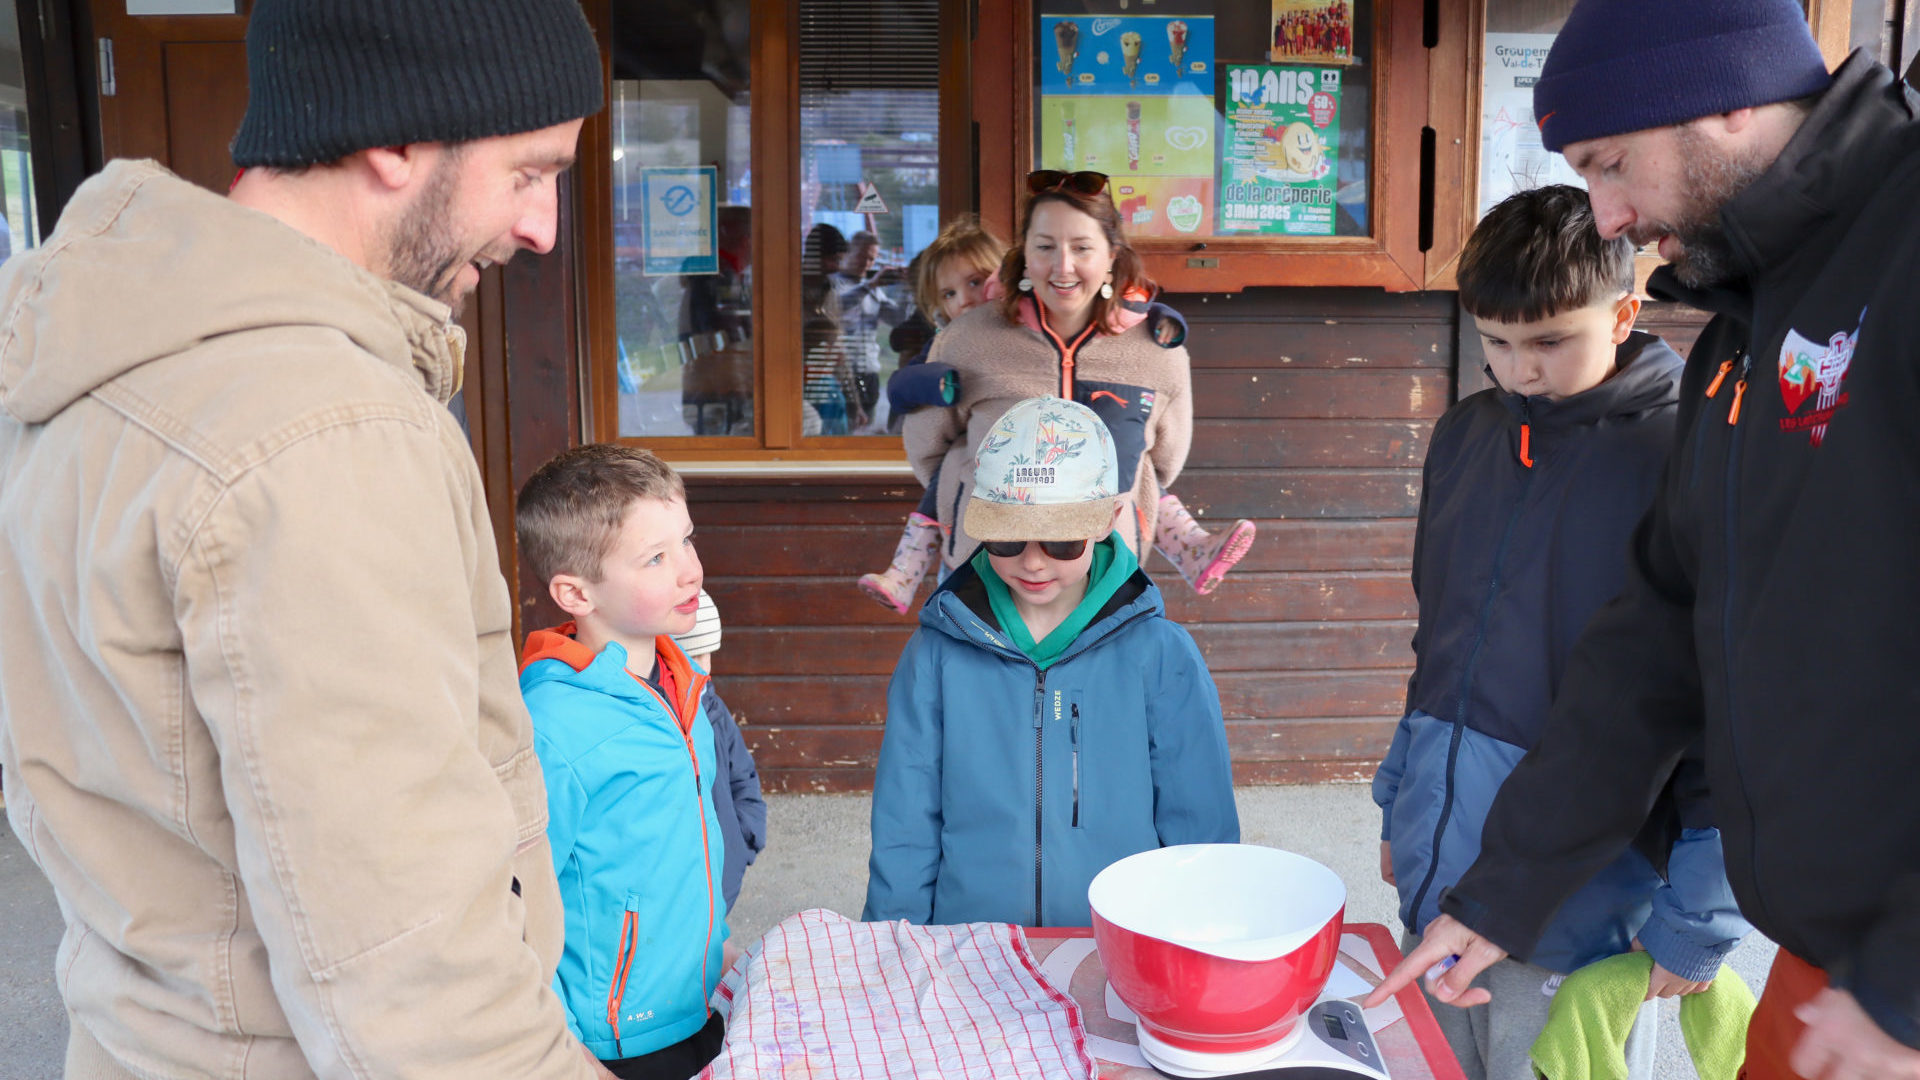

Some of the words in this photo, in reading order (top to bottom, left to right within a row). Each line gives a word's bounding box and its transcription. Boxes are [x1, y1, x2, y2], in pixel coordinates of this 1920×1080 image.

[1229, 68, 1259, 103] 10
[1261, 70, 1315, 105] ANS
[1226, 184, 1244, 202] de
[1247, 184, 1262, 202] la
[1264, 184, 1332, 205] crêperie
[1225, 204, 1233, 219] 3
[1234, 204, 1259, 220] MAI
[1260, 205, 1291, 221] 2025
[1054, 690, 1062, 721] WEDZE
